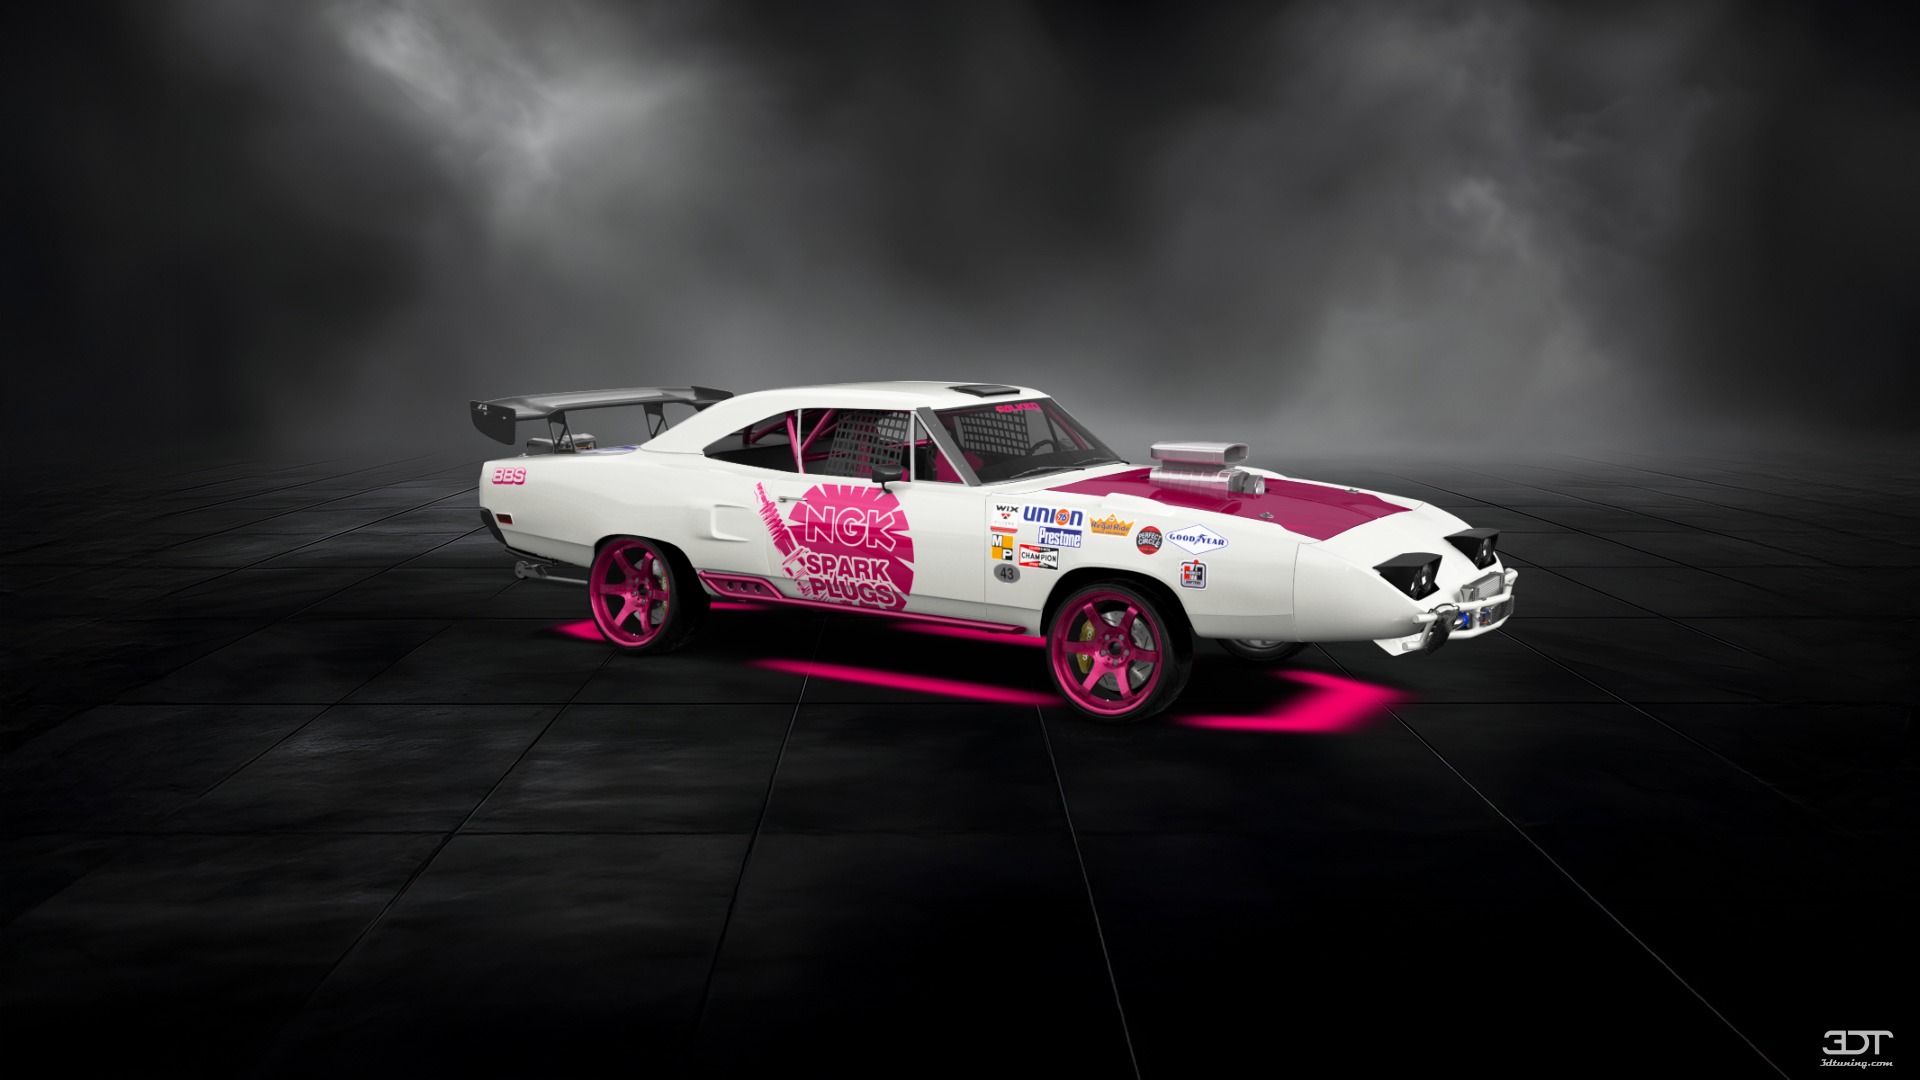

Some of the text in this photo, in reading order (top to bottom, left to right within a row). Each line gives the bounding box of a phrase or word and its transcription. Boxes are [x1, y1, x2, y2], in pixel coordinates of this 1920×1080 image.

[492, 467, 526, 485] BBS
[996, 505, 1019, 513] WIX
[805, 505, 896, 552] NGK
[1091, 521, 1130, 532] Regal Ride
[992, 535, 1003, 547] M
[1039, 527, 1081, 548] Prestone
[1138, 531, 1162, 541] PERFECT
[1138, 538, 1161, 548] CIRCLE
[1002, 549, 1013, 560] P
[1021, 551, 1057, 562] CHAMPION
[805, 553, 893, 582] SPARK
[1000, 567, 1014, 580] 43
[808, 578, 897, 607] PLUGS
